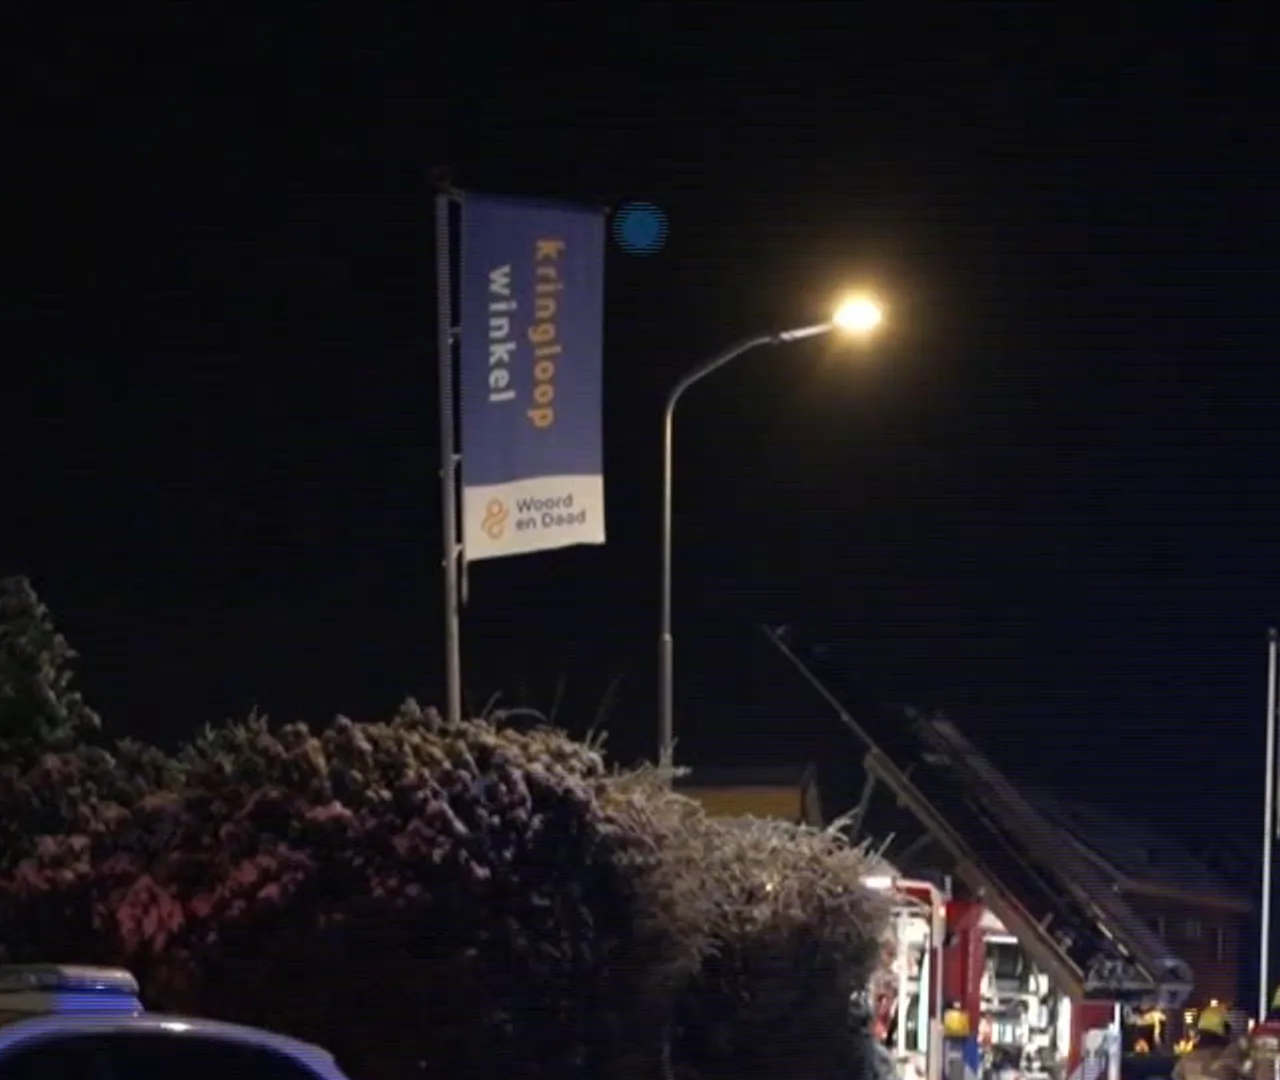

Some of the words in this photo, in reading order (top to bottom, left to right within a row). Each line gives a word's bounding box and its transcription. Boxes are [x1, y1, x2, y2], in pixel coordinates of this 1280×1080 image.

[487, 263, 518, 404] winkel
[526, 239, 566, 429] kringloop
[515, 492, 574, 514] Woord
[515, 515, 538, 531] en
[541, 508, 587, 529] Daad
